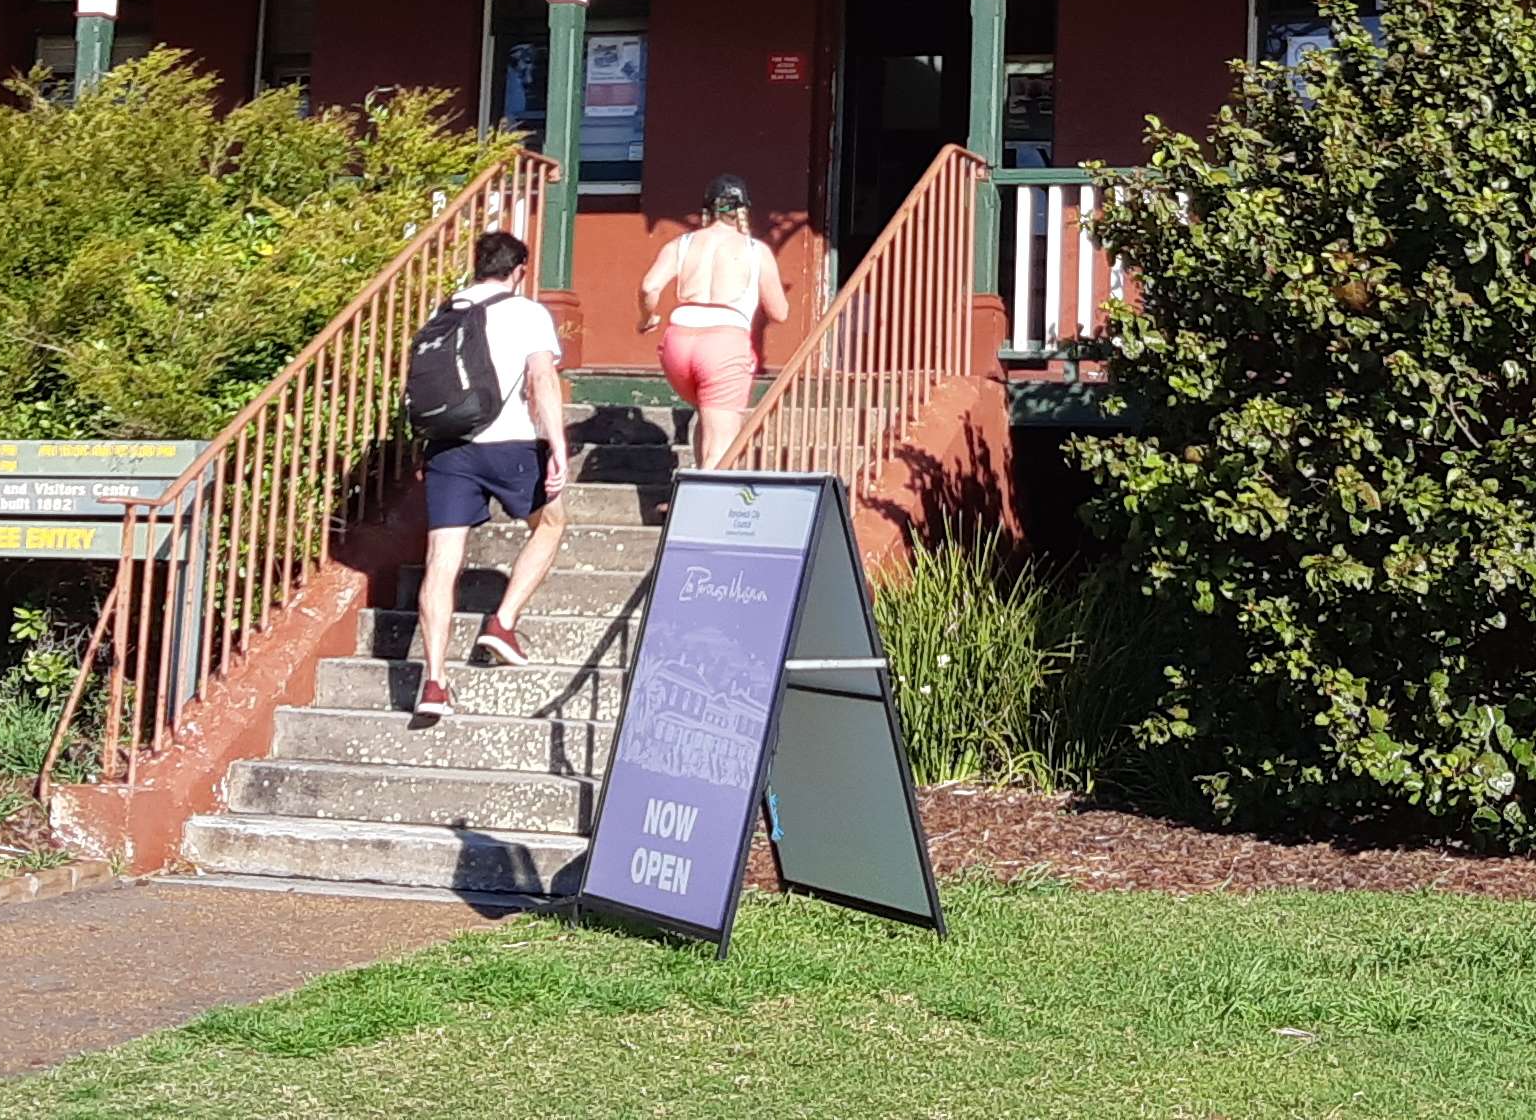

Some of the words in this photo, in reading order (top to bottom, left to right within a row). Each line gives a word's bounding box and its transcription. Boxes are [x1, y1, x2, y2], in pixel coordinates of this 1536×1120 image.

[3, 482, 28, 496] and
[35, 482, 86, 497] Visitors
[92, 483, 140, 497] Centre
[0, 497, 31, 511] built
[26, 527, 97, 550] ENTRY
[643, 798, 698, 842] NOW
[631, 847, 692, 895] OPEN
